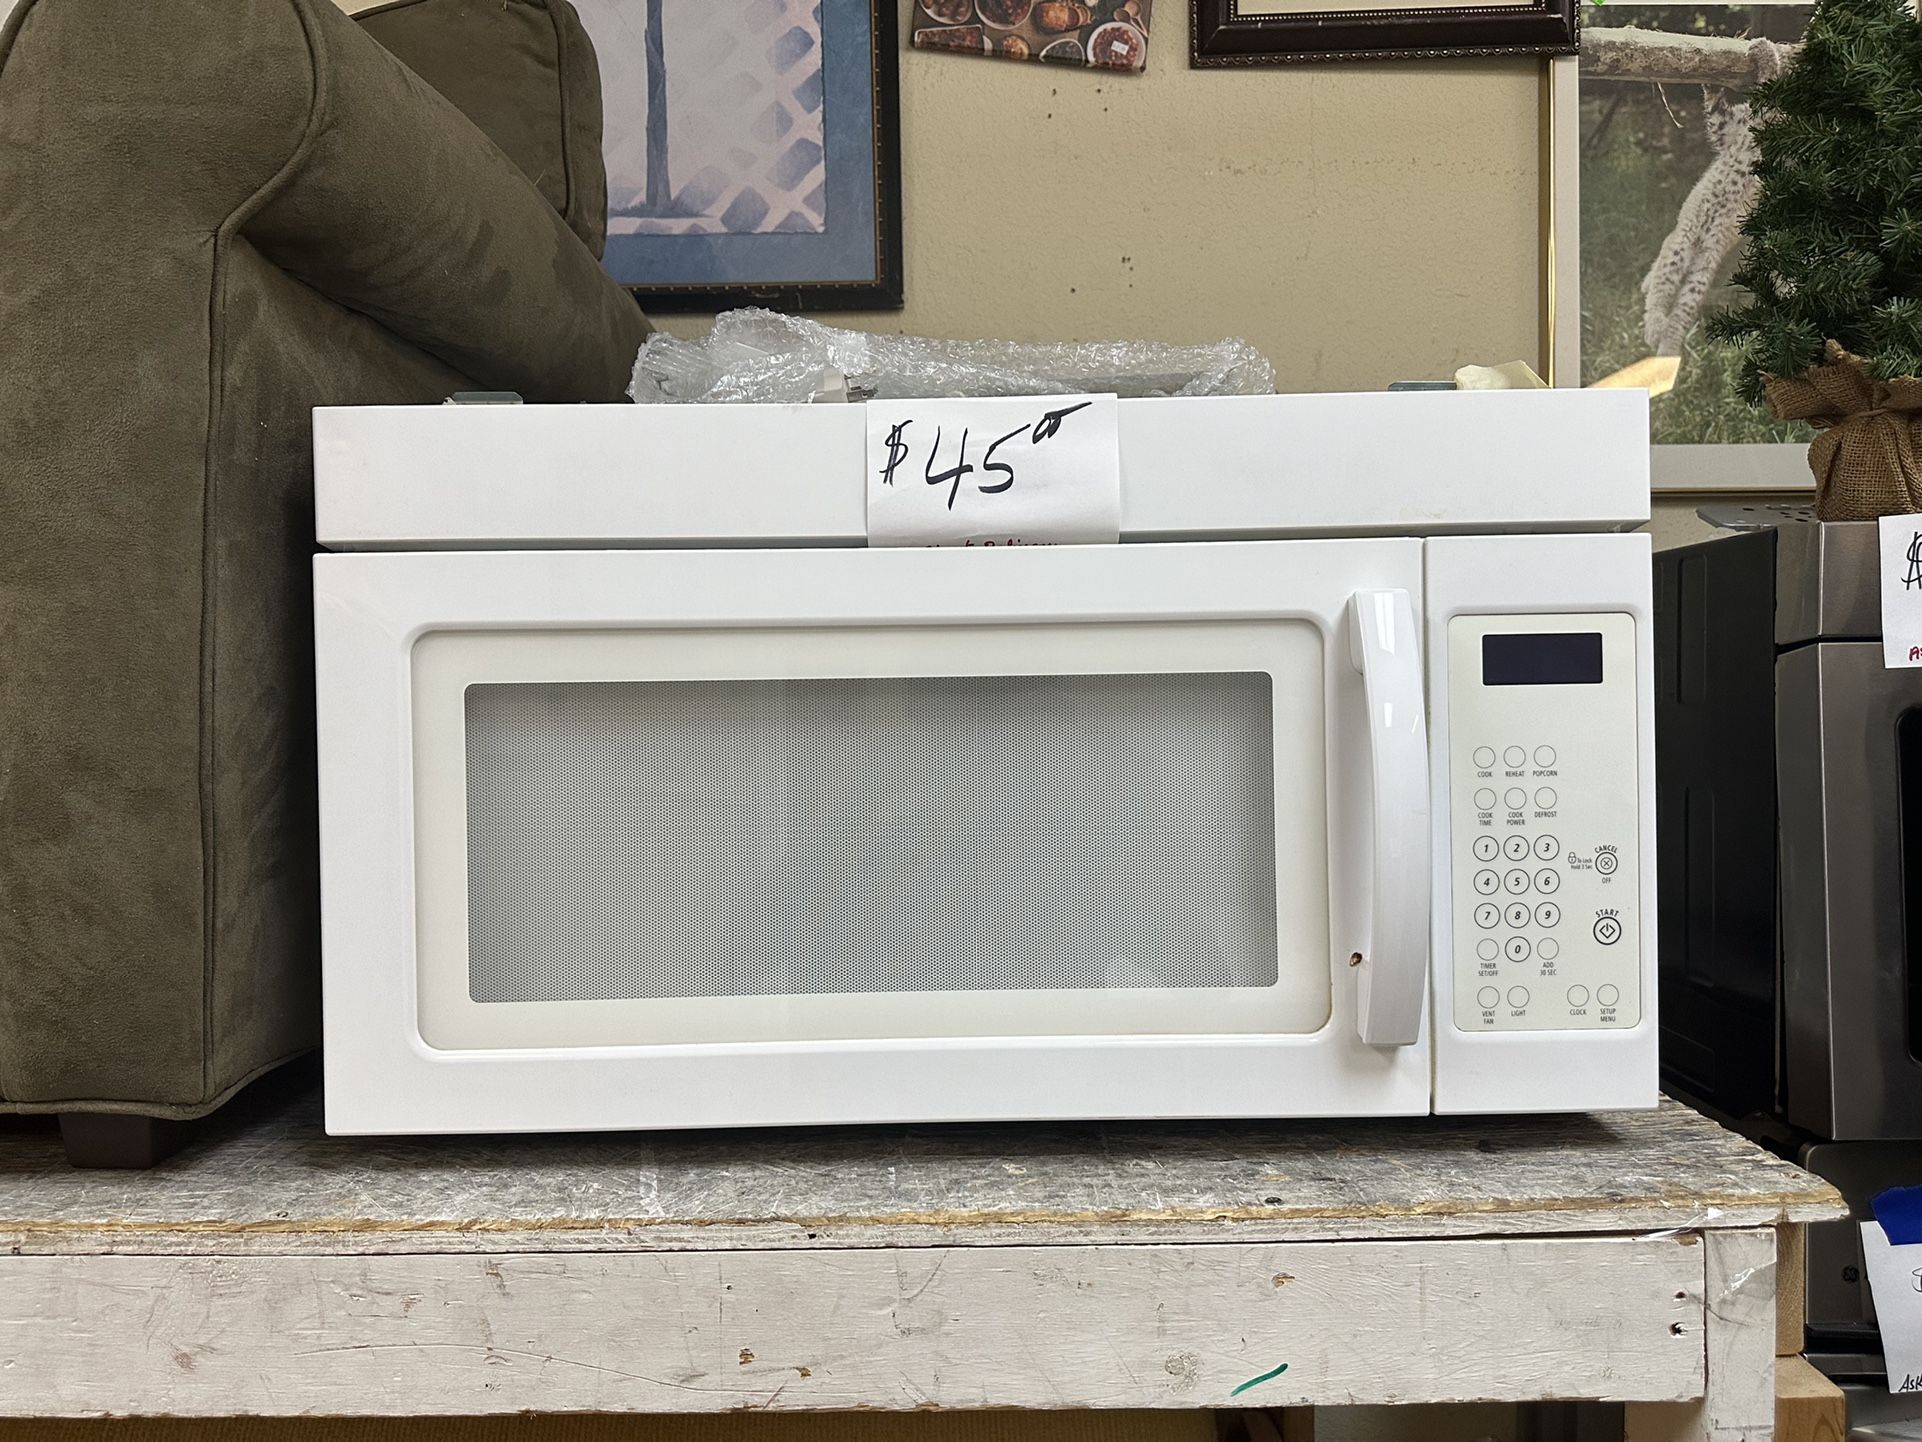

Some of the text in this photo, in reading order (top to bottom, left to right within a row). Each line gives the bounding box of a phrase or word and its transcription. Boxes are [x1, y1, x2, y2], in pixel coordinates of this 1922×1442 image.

[1484, 844, 1489, 853] 1
[1513, 843, 1520, 852] 2
[1543, 843, 1550, 852] 3
[1594, 844, 1618, 854] CANCEL
[1483, 877, 1490, 886] 4
[1514, 877, 1520, 886] 5
[1544, 876, 1551, 886] 6
[1484, 911, 1490, 920] 7
[1514, 910, 1521, 920] 8
[1544, 910, 1551, 919] 9
[1595, 908, 1619, 918] START
[1514, 944, 1521, 954] 0
